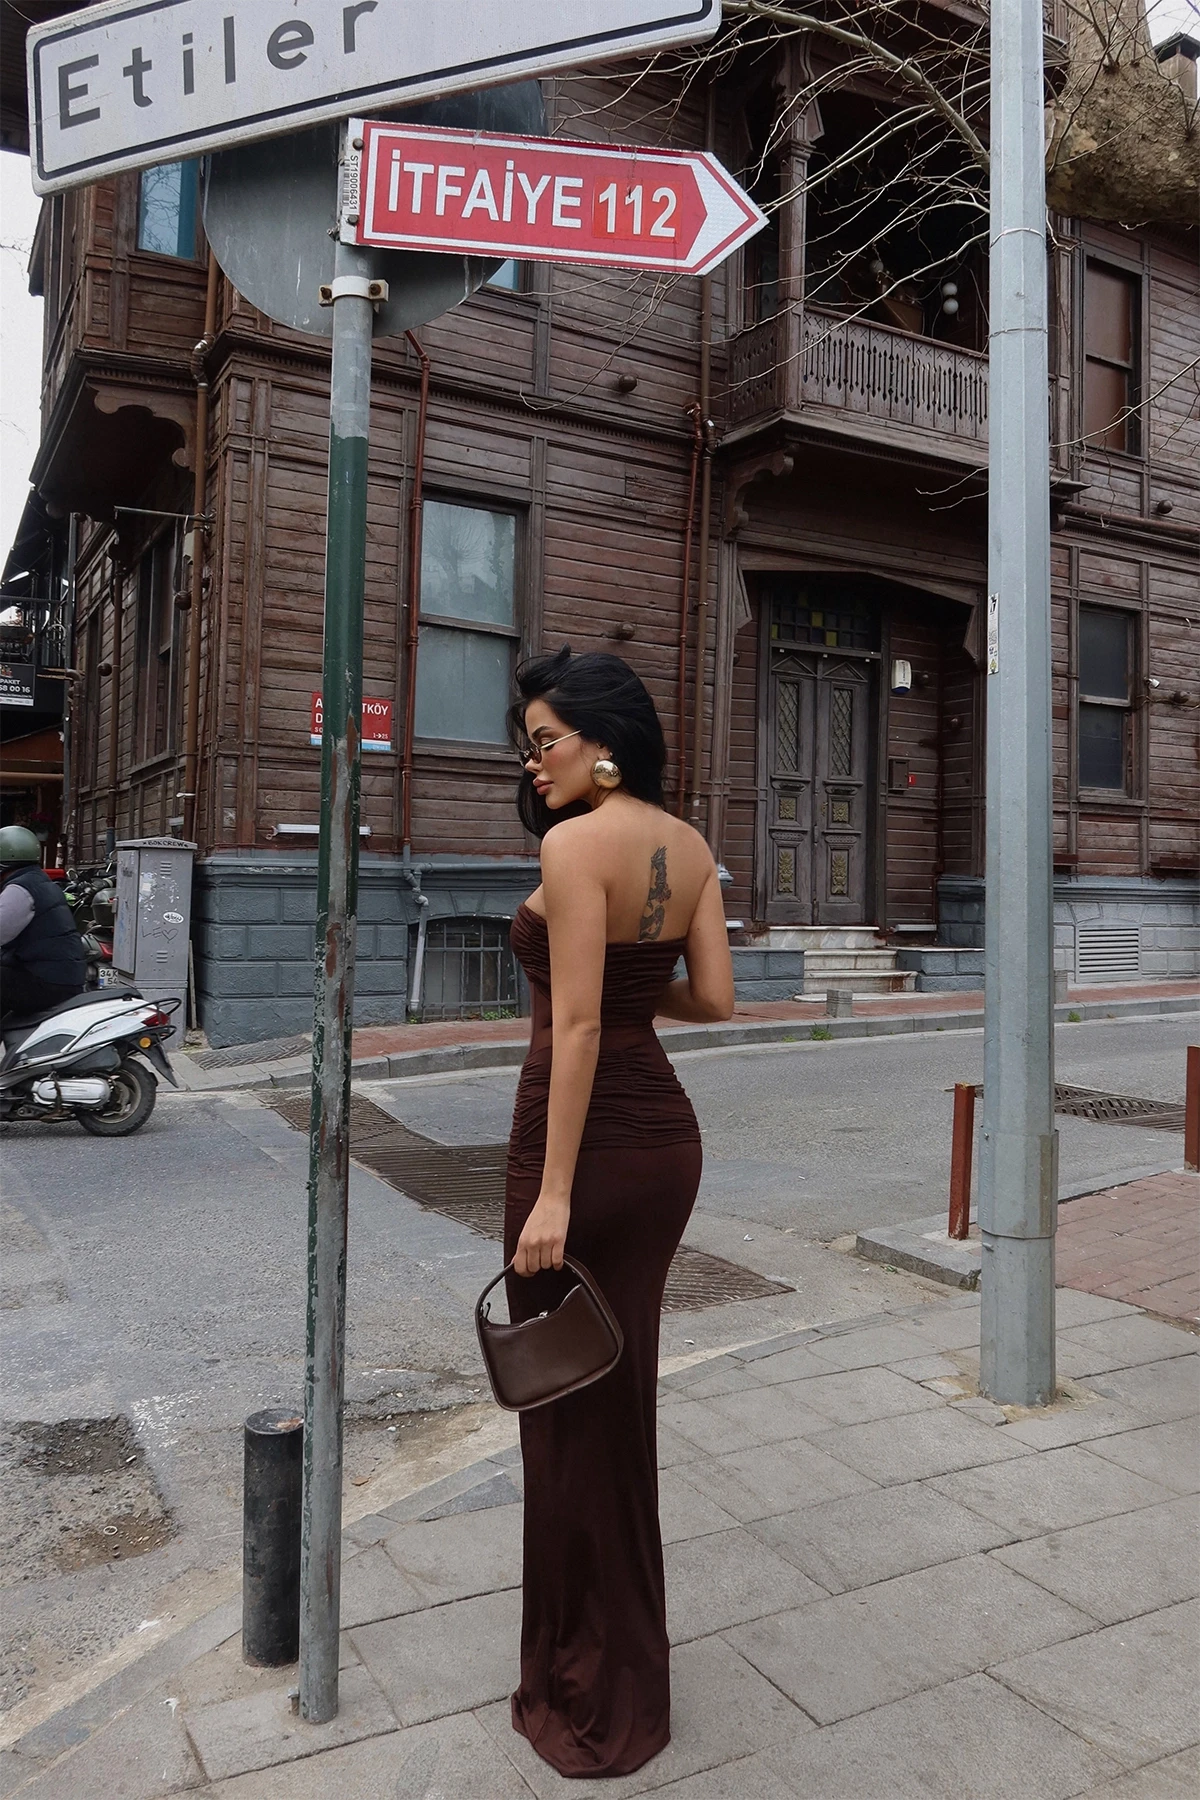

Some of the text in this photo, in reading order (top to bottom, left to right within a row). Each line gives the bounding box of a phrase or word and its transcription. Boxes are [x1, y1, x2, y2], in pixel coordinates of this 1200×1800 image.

[58, 0, 378, 130] Etiler
[350, 155, 359, 210] ST19006431
[388, 149, 677, 238] İTFAİYE 112
[100, 969, 111, 977] 34
